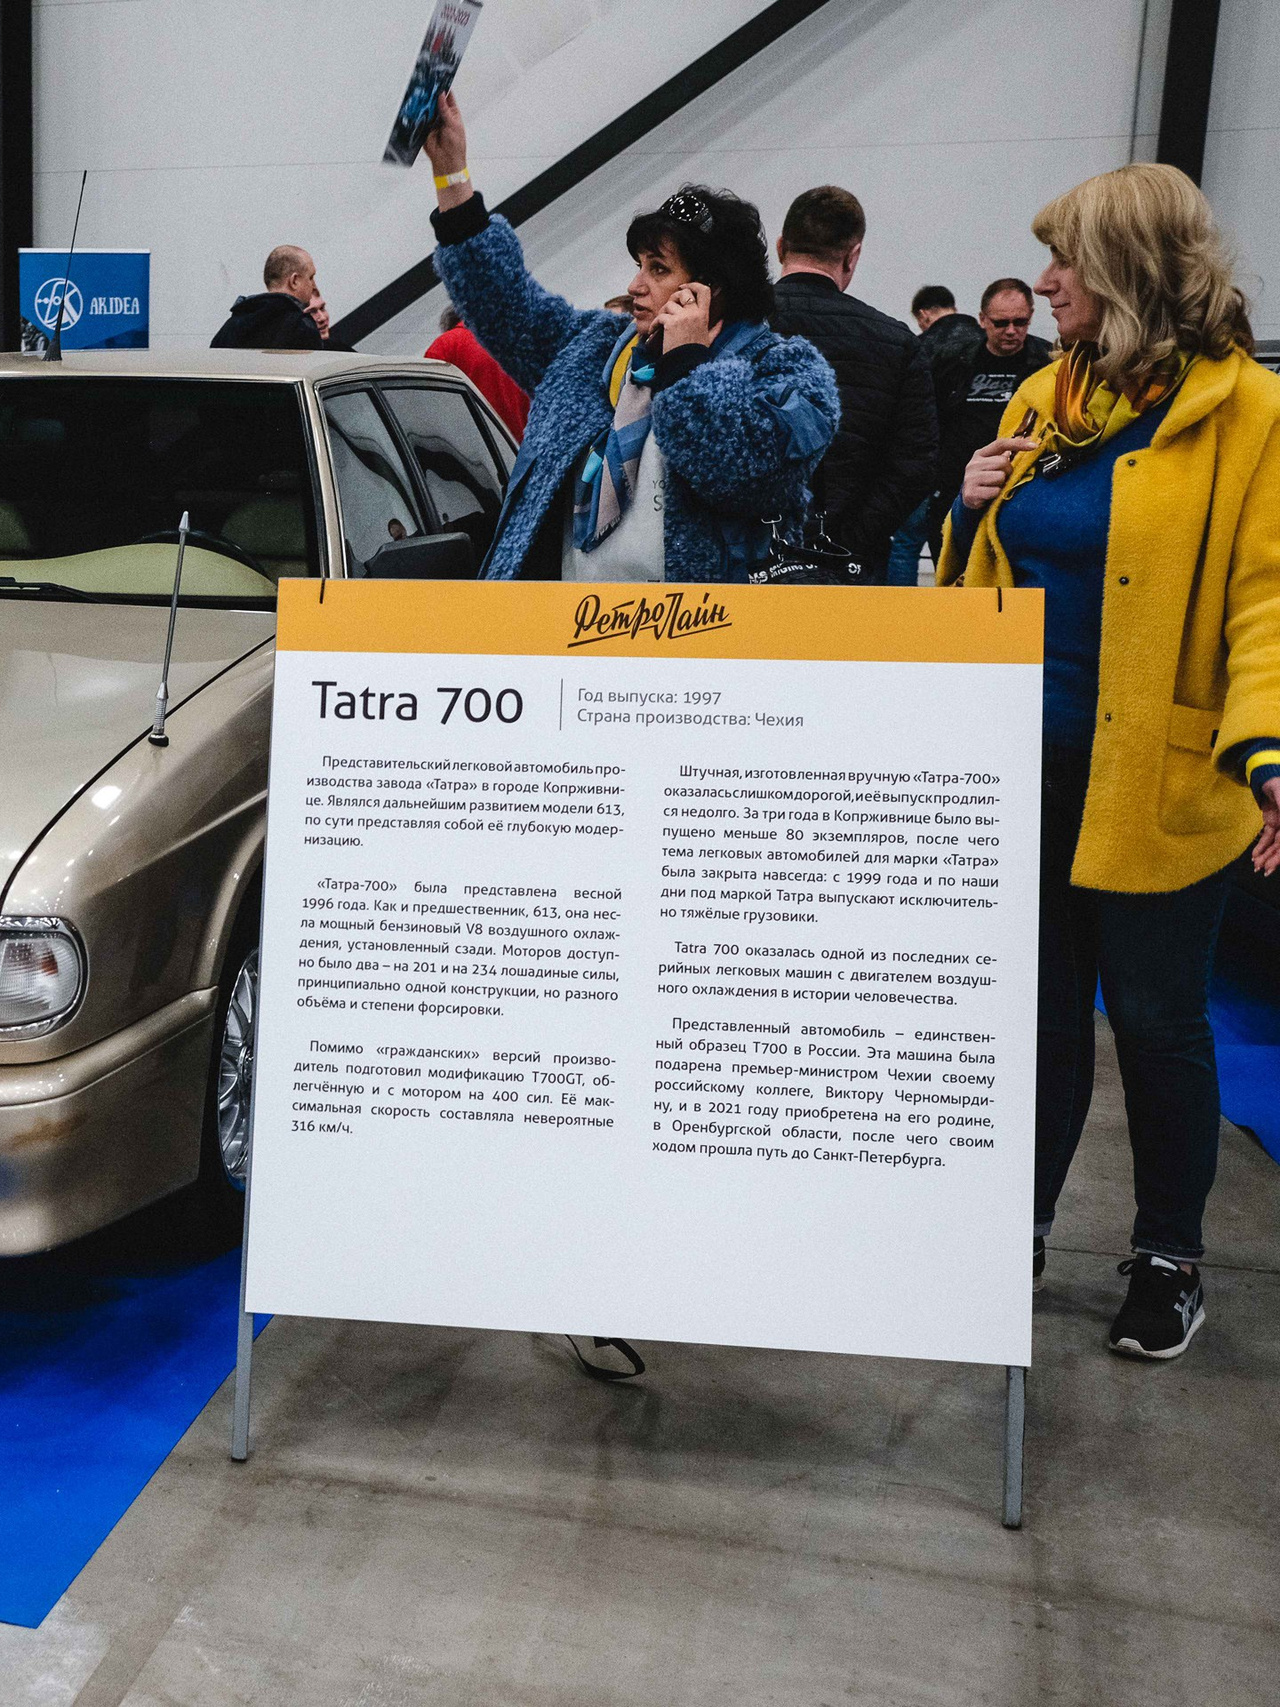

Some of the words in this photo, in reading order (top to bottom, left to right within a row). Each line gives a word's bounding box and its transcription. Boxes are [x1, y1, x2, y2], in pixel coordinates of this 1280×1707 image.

[89, 297, 140, 315] AKIDEA
[312, 681, 418, 720] Tatra
[437, 687, 524, 725] 700
[578, 687, 604, 703] Год
[608, 691, 678, 707] выпуска:
[683, 691, 722, 706] 1997
[577, 708, 631, 726] Страна
[635, 713, 751, 728] производства:
[755, 712, 804, 727] Чехия
[322, 755, 451, 771] Представительский
[451, 760, 513, 772] легковой
[513, 761, 594, 775] автомобиль
[595, 765, 626, 778] про-
[679, 765, 743, 781] Штучная,
[744, 769, 846, 781] изготовленная
[848, 771, 911, 786] вручную
[912, 770, 1001, 787] «Татра-700»
[306, 777, 373, 788] изводства
[376, 779, 422, 790] завода
[426, 778, 478, 794] «Татра»
[481, 782, 490, 792] в
[492, 782, 540, 796] городе
[543, 781, 625, 797] Копрживни-
[305, 796, 324, 807] це.
[327, 794, 381, 808] Являлся
[382, 797, 467, 811] дальнейшим
[469, 801, 540, 814] развитием
[542, 804, 593, 815] модели
[596, 802, 625, 817] 613,
[304, 816, 321, 826] по
[324, 816, 354, 830] сути
[357, 818, 441, 831] представляя
[444, 818, 484, 831] собой
[487, 820, 504, 832] её
[507, 820, 572, 837] глубокую
[574, 824, 624, 839] модер-
[662, 827, 716, 841] пущено
[723, 829, 778, 840] меньше
[785, 828, 804, 841] 80
[812, 832, 908, 847] экземпляров,
[916, 835, 959, 846] после
[967, 836, 1000, 847] чего
[304, 836, 364, 847] низацию.
[661, 847, 694, 858] тема
[698, 848, 763, 860] легковых
[766, 849, 860, 863] автомобилей
[863, 854, 890, 865] для
[893, 854, 938, 868] марки
[942, 853, 999, 870] «Татра»
[317, 877, 398, 893] «Татра-700»
[414, 880, 448, 894] была
[463, 885, 557, 898] представлена
[573, 888, 622, 900] весной
[660, 888, 686, 898] дни
[690, 889, 716, 900] под
[720, 888, 772, 903] маркой
[776, 888, 814, 905] Татра
[818, 893, 895, 907] выпускают
[899, 896, 999, 909] исключитель-
[660, 908, 677, 918] но
[680, 907, 741, 920] тяжёлые
[743, 911, 818, 925] грузовики.
[300, 919, 315, 929] ла
[319, 918, 375, 931] мощный
[379, 919, 461, 934] бензиновый
[465, 922, 483, 935] V8
[488, 926, 569, 940] воздушного
[573, 929, 621, 940] охлаж-
[299, 938, 342, 951] дения,
[347, 940, 450, 954] установленный
[454, 945, 496, 956] сзади.
[502, 944, 562, 961] Моторов
[566, 949, 620, 964] доступ-
[674, 940, 707, 955] Tatra
[713, 943, 740, 956] 700
[745, 946, 816, 959] оказалась
[820, 947, 865, 961] одной
[870, 951, 887, 962] из
[892, 952, 970, 965] последних
[975, 955, 998, 966] се-
[658, 961, 711, 976] рийных
[715, 966, 780, 978] легковых
[785, 968, 832, 980] машин
[837, 970, 845, 981] с
[849, 971, 932, 984] двигателем
[937, 974, 997, 989] воздуш-
[297, 978, 401, 992] принципиально
[405, 981, 447, 994] одной
[450, 985, 540, 1000] конструкции,
[543, 989, 561, 999] но
[565, 989, 619, 1002] разного
[657, 984, 689, 995] ного
[691, 985, 778, 998] охлаждения
[781, 988, 789, 999] в
[793, 989, 850, 1004] истории
[854, 992, 958, 1006] человечества.
[296, 995, 346, 1009] объёма
[349, 1000, 358, 1010] и
[361, 1000, 415, 1012] степени
[417, 1000, 504, 1018] форсировки.
[672, 1017, 790, 1034] Представленный
[800, 1024, 886, 1039] автомобиль
[914, 1030, 996, 1043] единствен-
[309, 1040, 364, 1055] Помимо
[376, 1046, 480, 1060] «гражданских»
[492, 1050, 541, 1065] версий
[553, 1054, 616, 1068] произво-
[293, 1062, 339, 1073] дитель
[345, 1064, 422, 1077] подготовил
[427, 1067, 525, 1083] модификацию
[592, 1074, 616, 1087] об-
[655, 1060, 722, 1074] подарена
[731, 1063, 878, 1082] премьер-министром
[887, 1068, 932, 1082] Чехии
[942, 1073, 996, 1089] своему
[654, 1079, 745, 1098] российскому
[756, 1085, 814, 1099] коллеге,
[825, 1085, 884, 1105] Виктору
[894, 1089, 995, 1109] Черномырди-
[291, 1101, 362, 1114] симальная
[370, 1105, 431, 1120] скорость
[439, 1109, 514, 1123] составляла
[523, 1114, 614, 1128] невероятные
[291, 1119, 316, 1132] 316
[318, 1121, 353, 1134] км/ч.
[653, 1121, 661, 1131] в
[672, 1119, 771, 1138] Оренбургской
[781, 1125, 842, 1142] области,
[852, 1131, 895, 1144] после
[906, 1134, 938, 1146] чего
[949, 1136, 995, 1149] своим
[652, 1142, 696, 1154] ходом
[699, 1144, 753, 1158] прошла
[756, 1147, 788, 1161] путь
[791, 1149, 810, 1160] до
[813, 1147, 946, 1169] Санкт-Петербурга.
